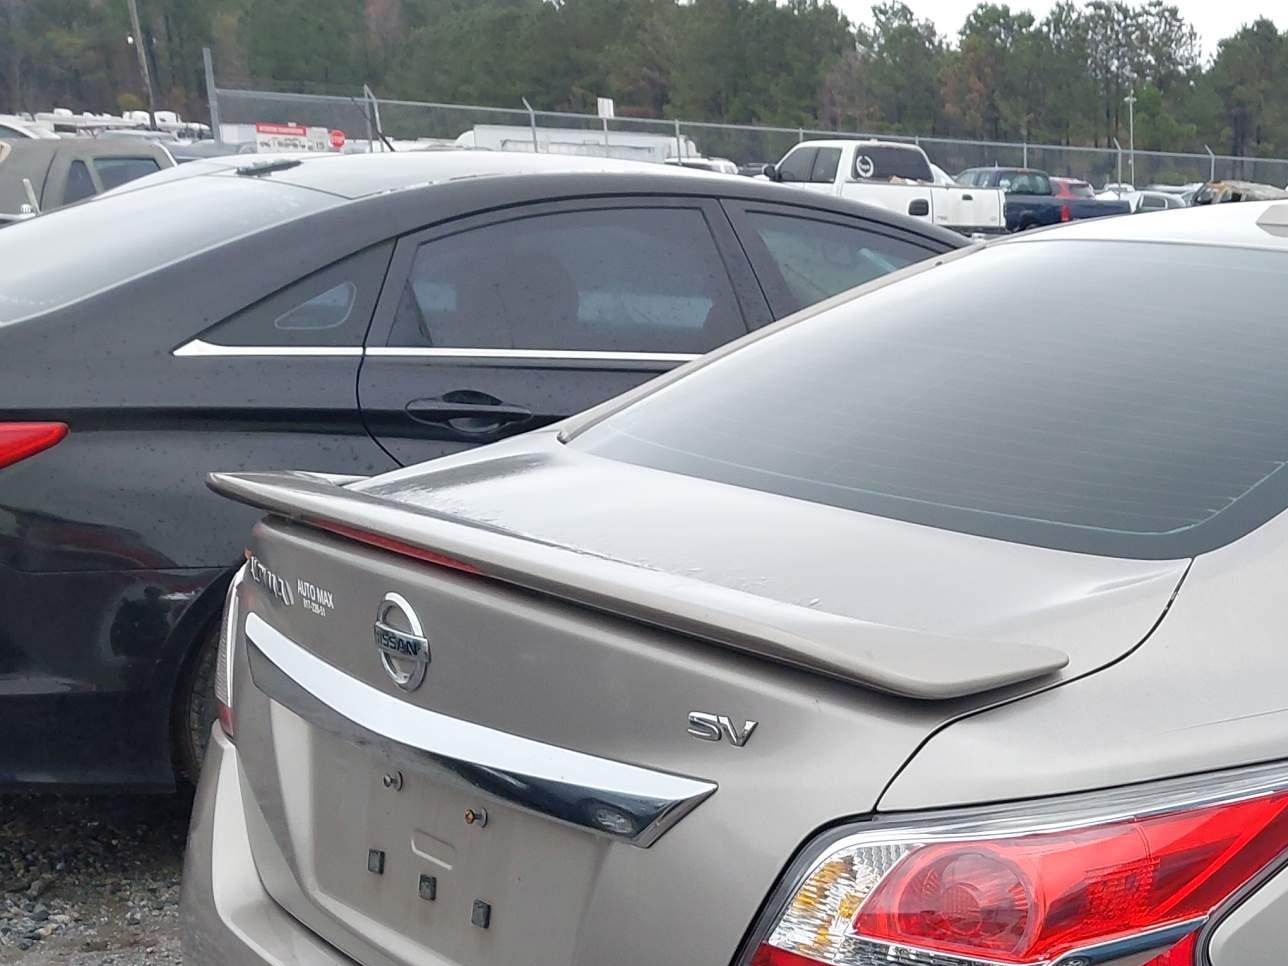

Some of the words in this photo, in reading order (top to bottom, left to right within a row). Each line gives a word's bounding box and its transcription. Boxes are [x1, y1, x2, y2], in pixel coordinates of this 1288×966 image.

[297, 578, 316, 601] AUTO
[316, 586, 335, 609] MAX
[376, 629, 419, 656] NISSAN
[687, 711, 759, 748] SV
